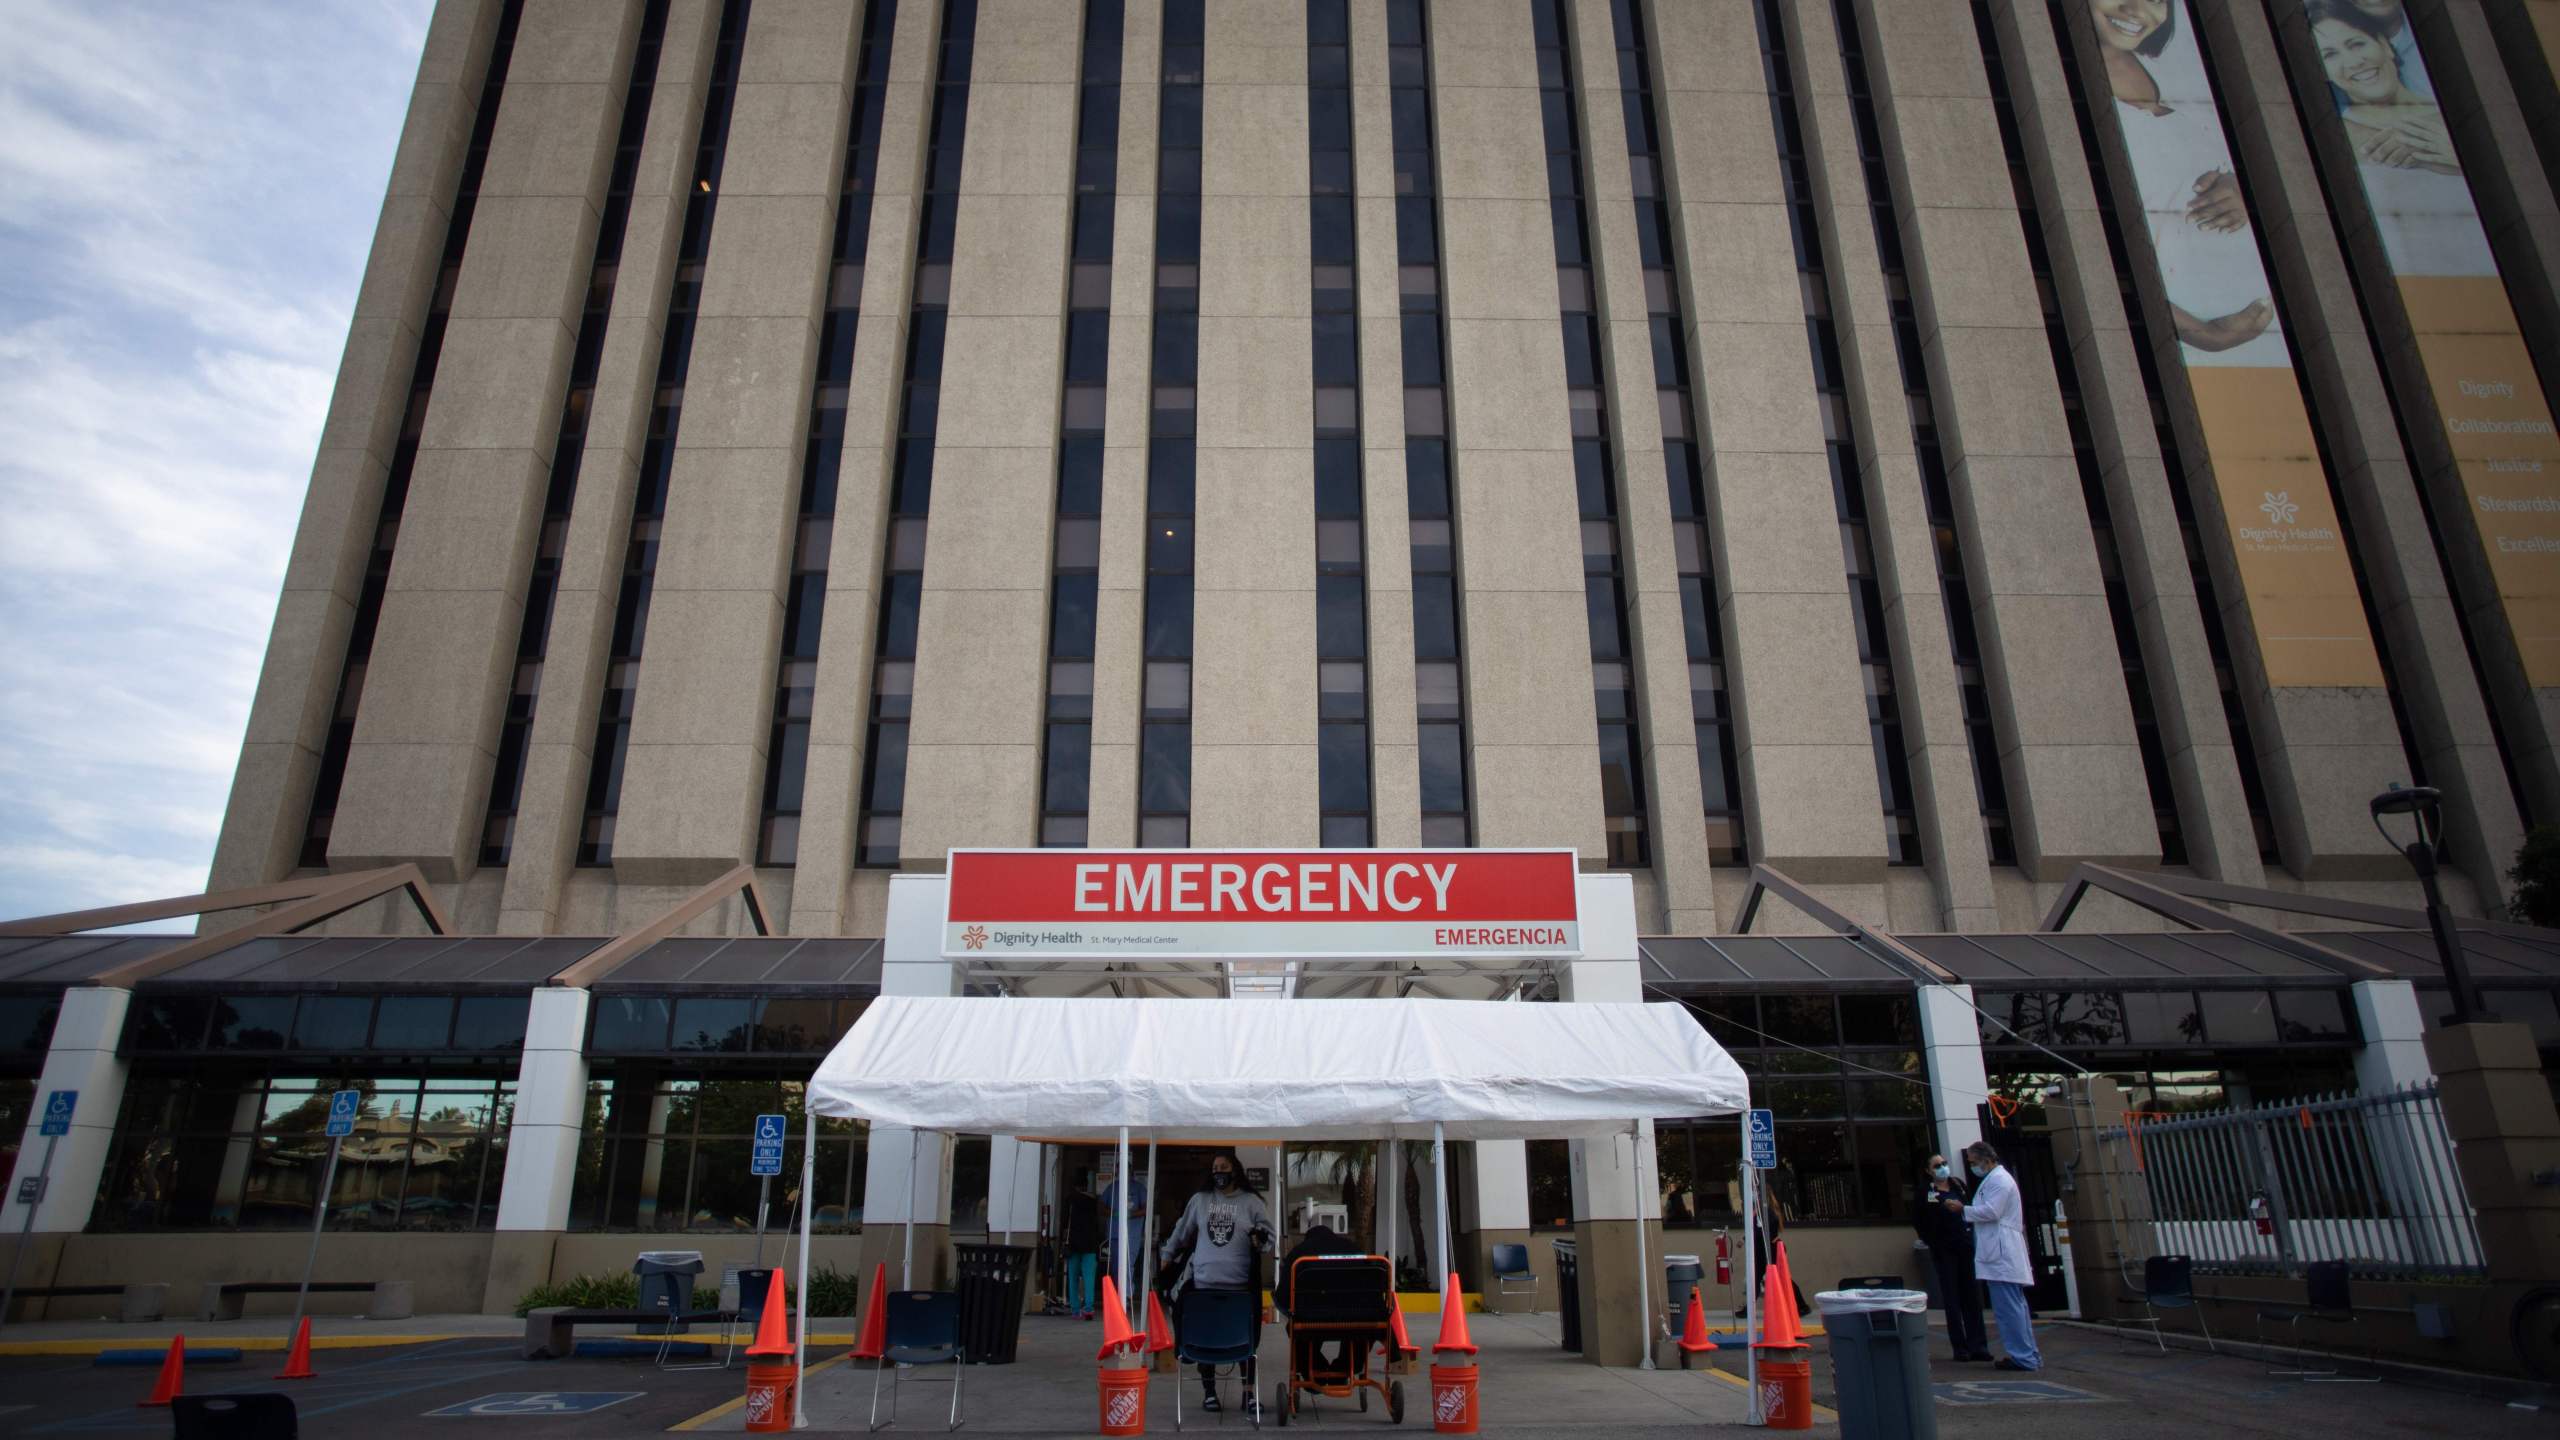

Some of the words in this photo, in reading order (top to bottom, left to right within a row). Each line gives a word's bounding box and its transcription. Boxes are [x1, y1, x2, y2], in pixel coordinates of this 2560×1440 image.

[2458, 380, 2514, 399] Dignity
[2448, 417, 2552, 433] Collaboration
[2487, 458, 2543, 473] Justice
[2240, 528, 2287, 542] Dignity
[2289, 528, 2335, 539] Health
[1075, 863, 1457, 912] EMERGENCY
[994, 932, 1038, 946] Dignity
[1041, 932, 1083, 943] Health
[1103, 937, 1122, 946] Mary
[1124, 936, 1152, 944] Medical
[1435, 928, 1567, 945] EMERGENCIA
[755, 1139, 782, 1147] PARKING
[1751, 1133, 1772, 1141] ARKING
[760, 1148, 776, 1157] ONLY
[1753, 1142, 1768, 1150] ONLY
